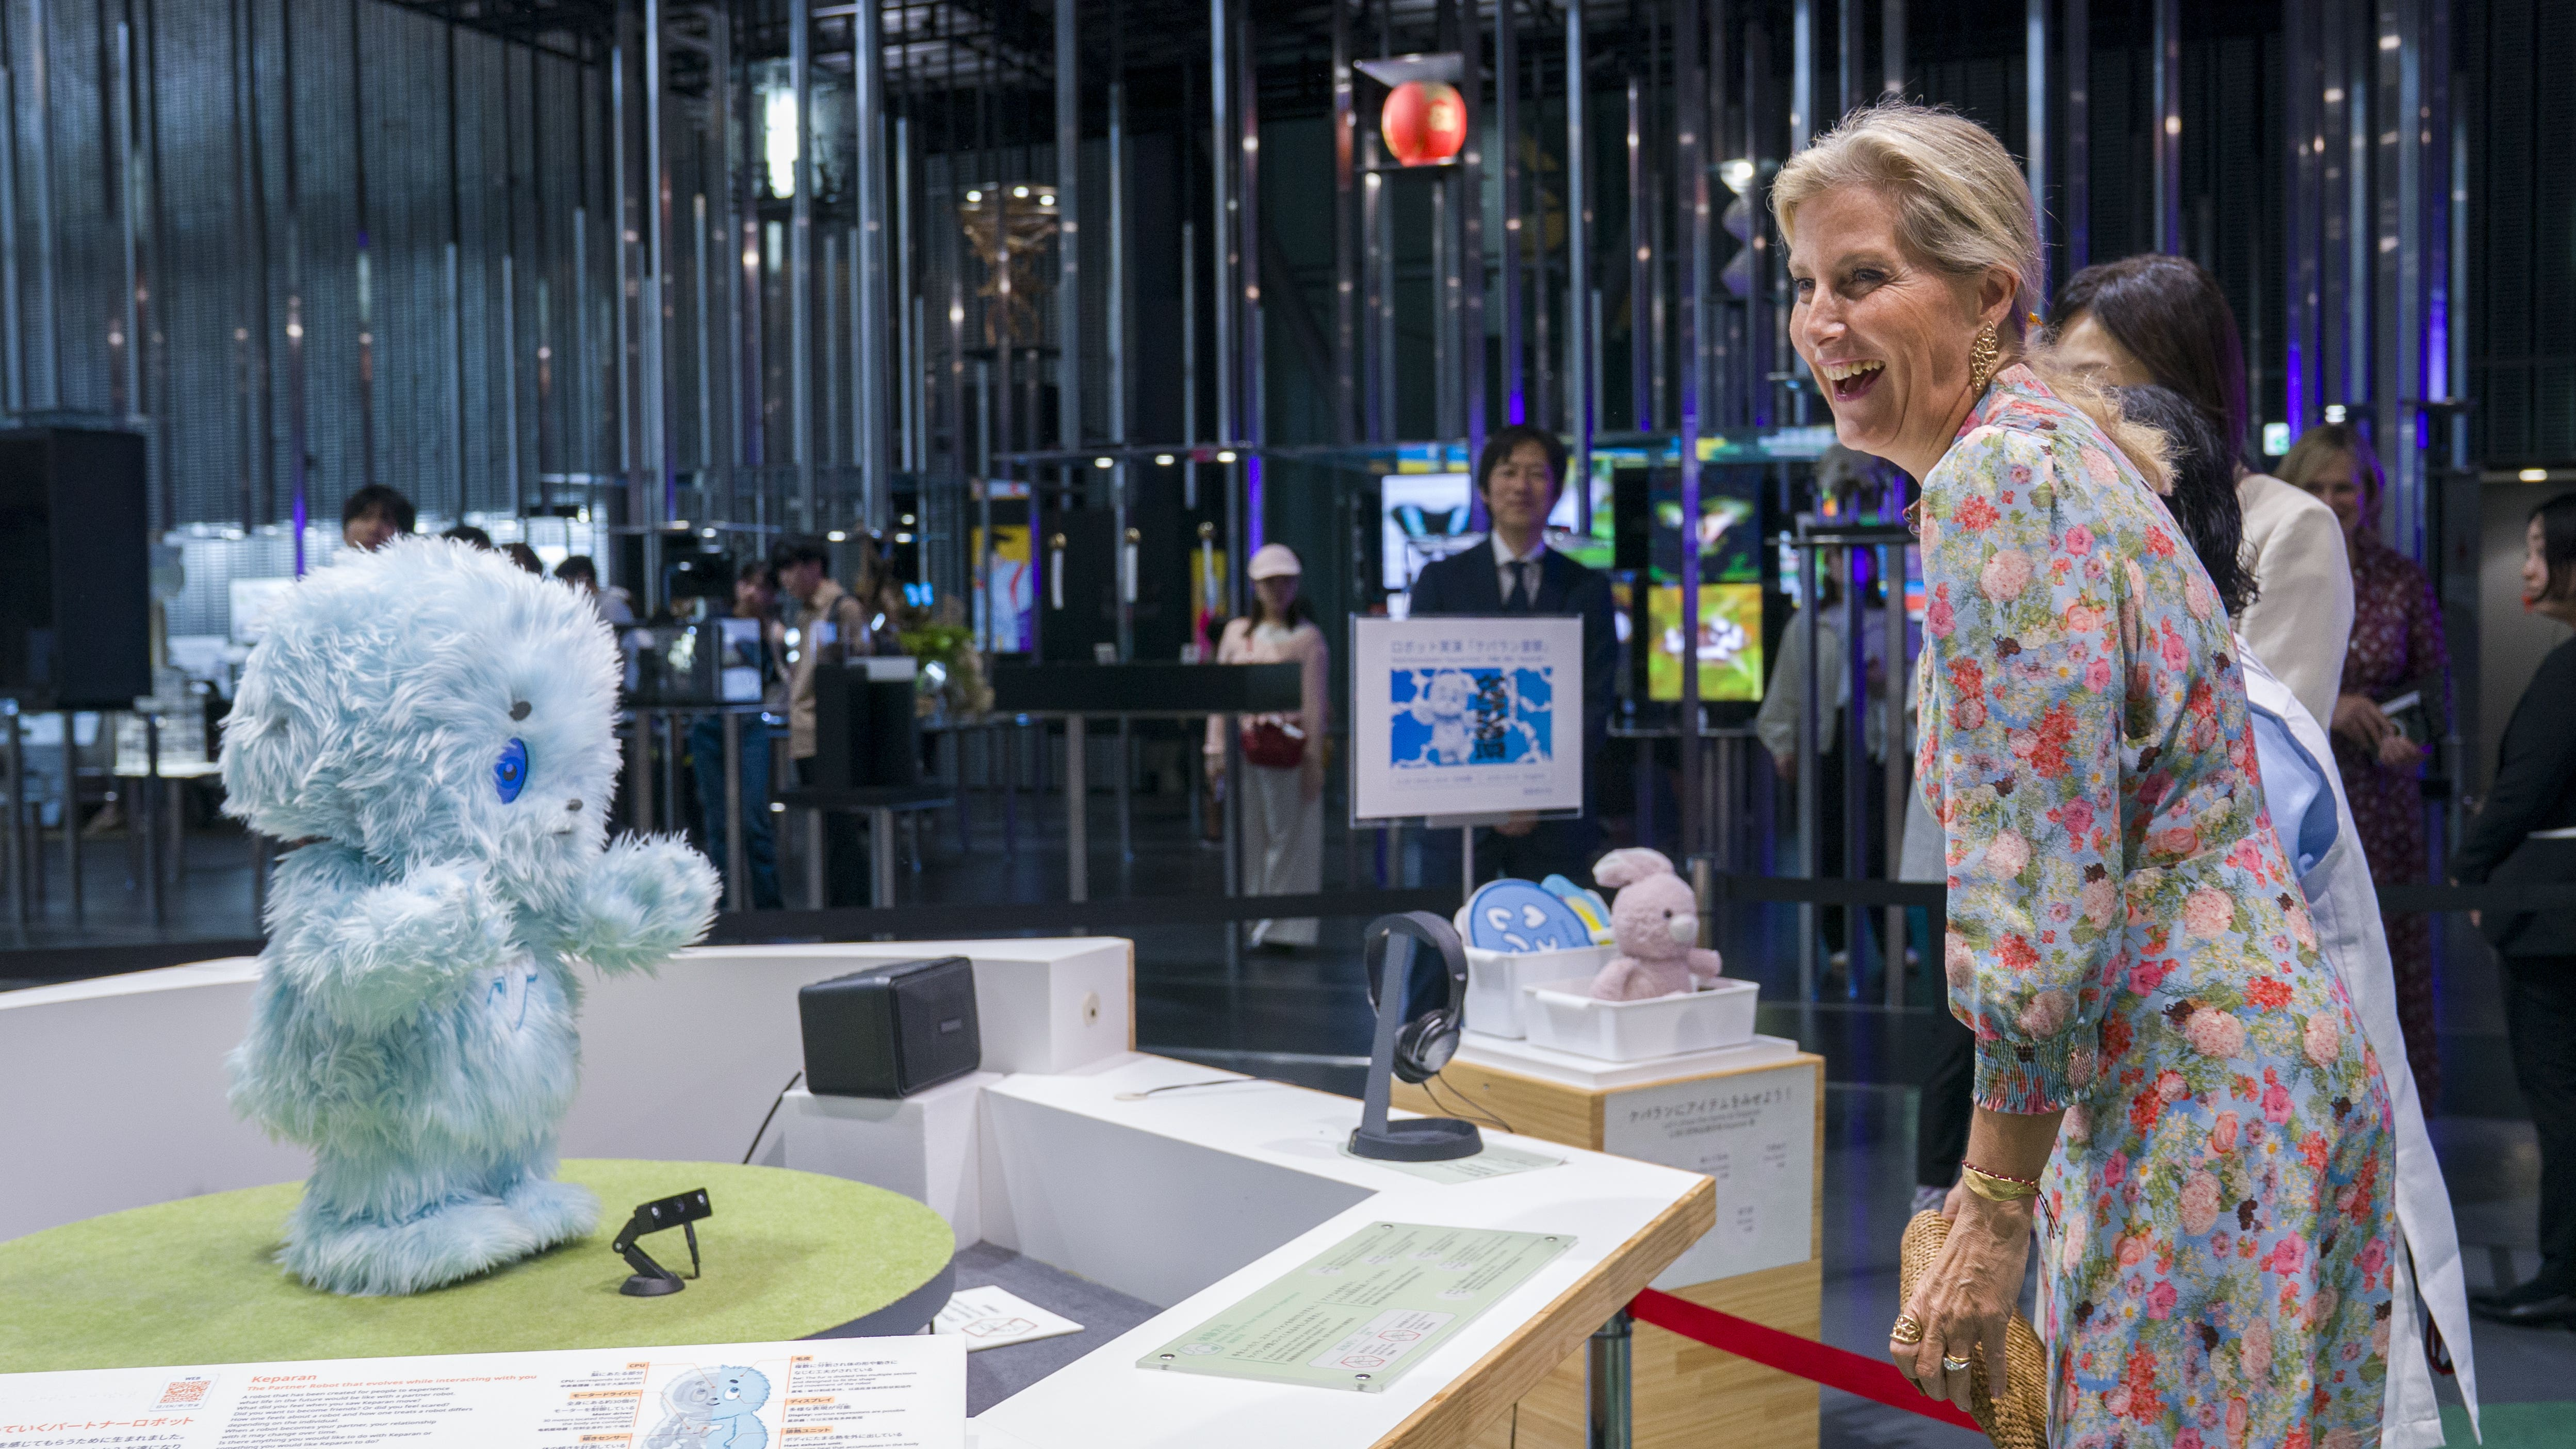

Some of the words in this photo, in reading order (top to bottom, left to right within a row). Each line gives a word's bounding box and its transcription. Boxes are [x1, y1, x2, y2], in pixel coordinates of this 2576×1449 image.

[251, 1375, 317, 1383] Keparan
[0, 1417, 194, 1433] ていくパートナーロボット
